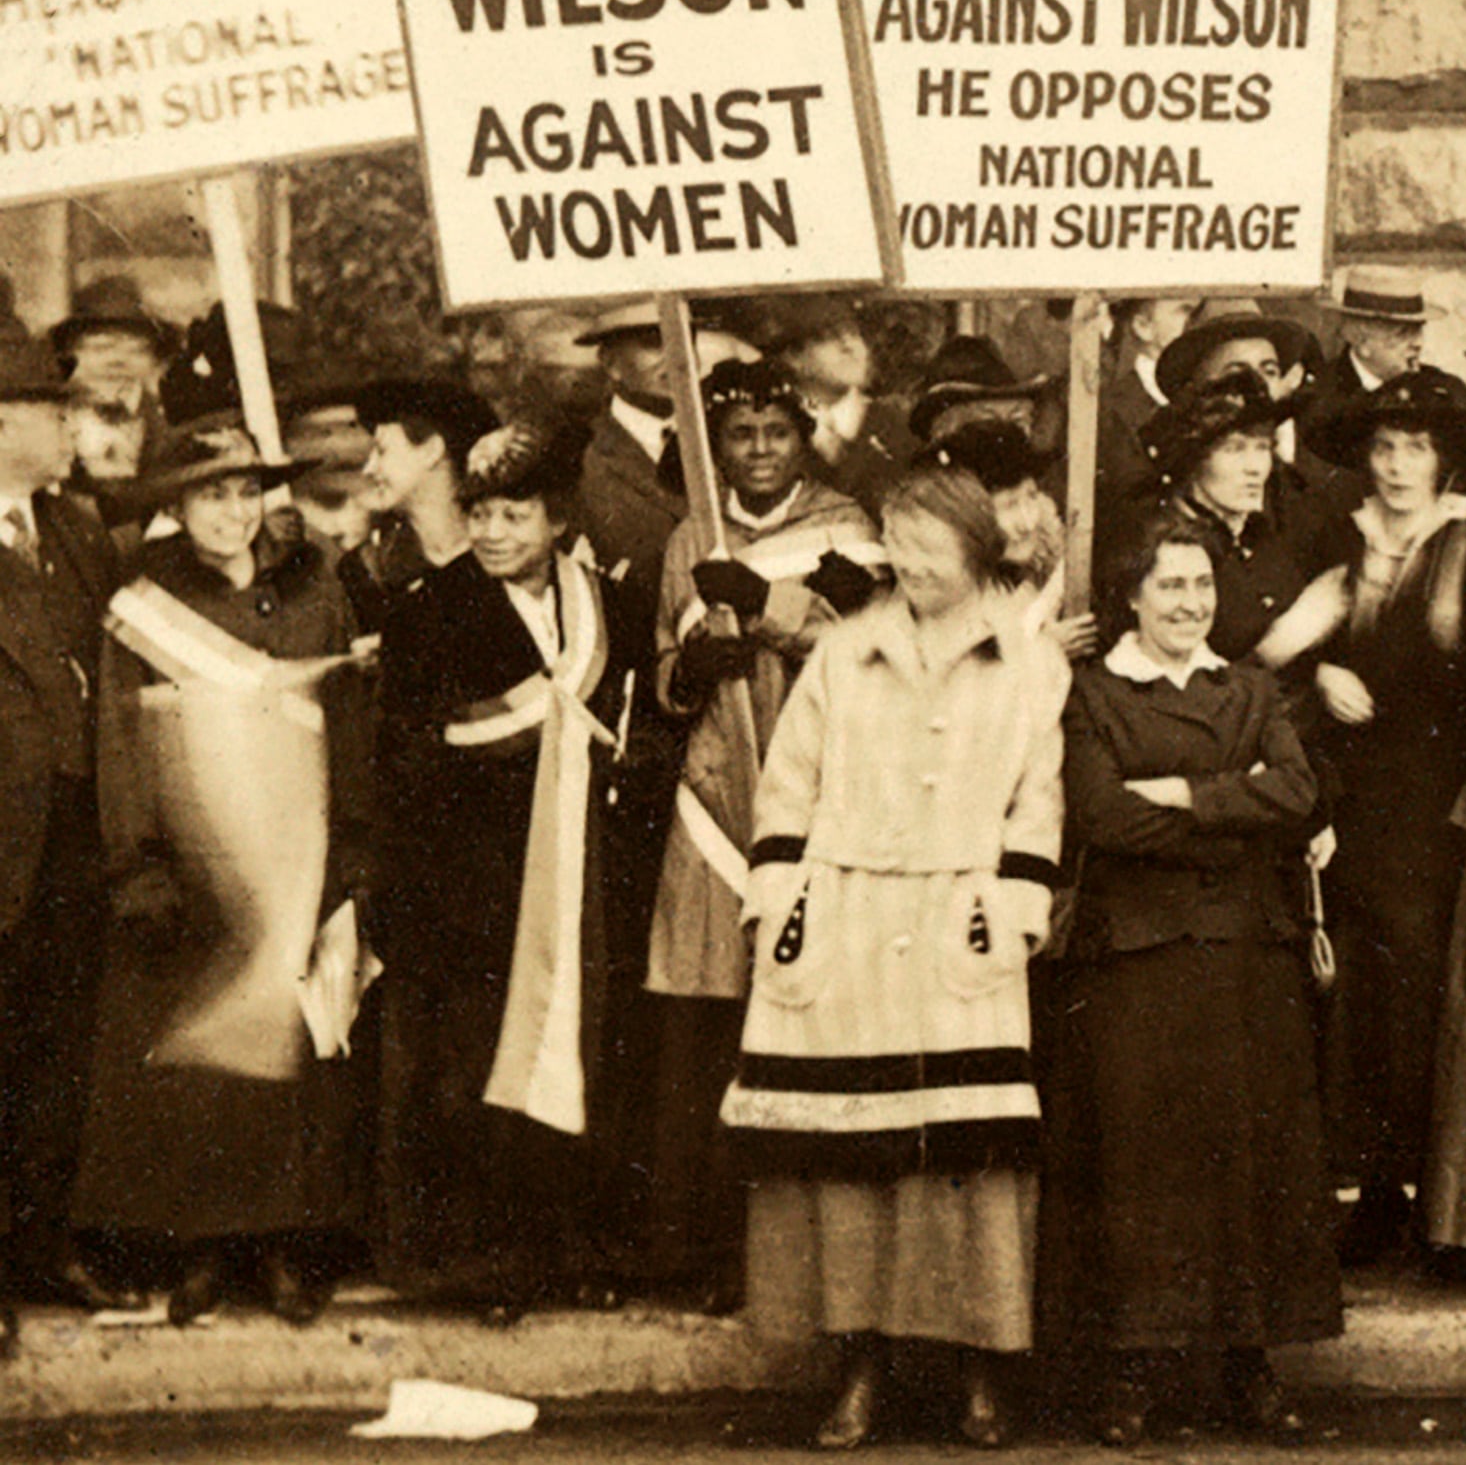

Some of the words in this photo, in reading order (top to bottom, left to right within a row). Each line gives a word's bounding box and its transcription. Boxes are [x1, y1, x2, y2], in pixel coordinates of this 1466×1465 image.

[592, 40, 655, 77] IS
[161, 47, 410, 129] SUFFRAGE
[916, 68, 990, 117] HE
[1009, 69, 1273, 122] OPPOSES
[466, 84, 823, 178] AGAINST
[979, 144, 1213, 188] NATIONAL
[494, 178, 799, 262] WOMEN
[1050, 203, 1301, 251] SUFFRAGE
